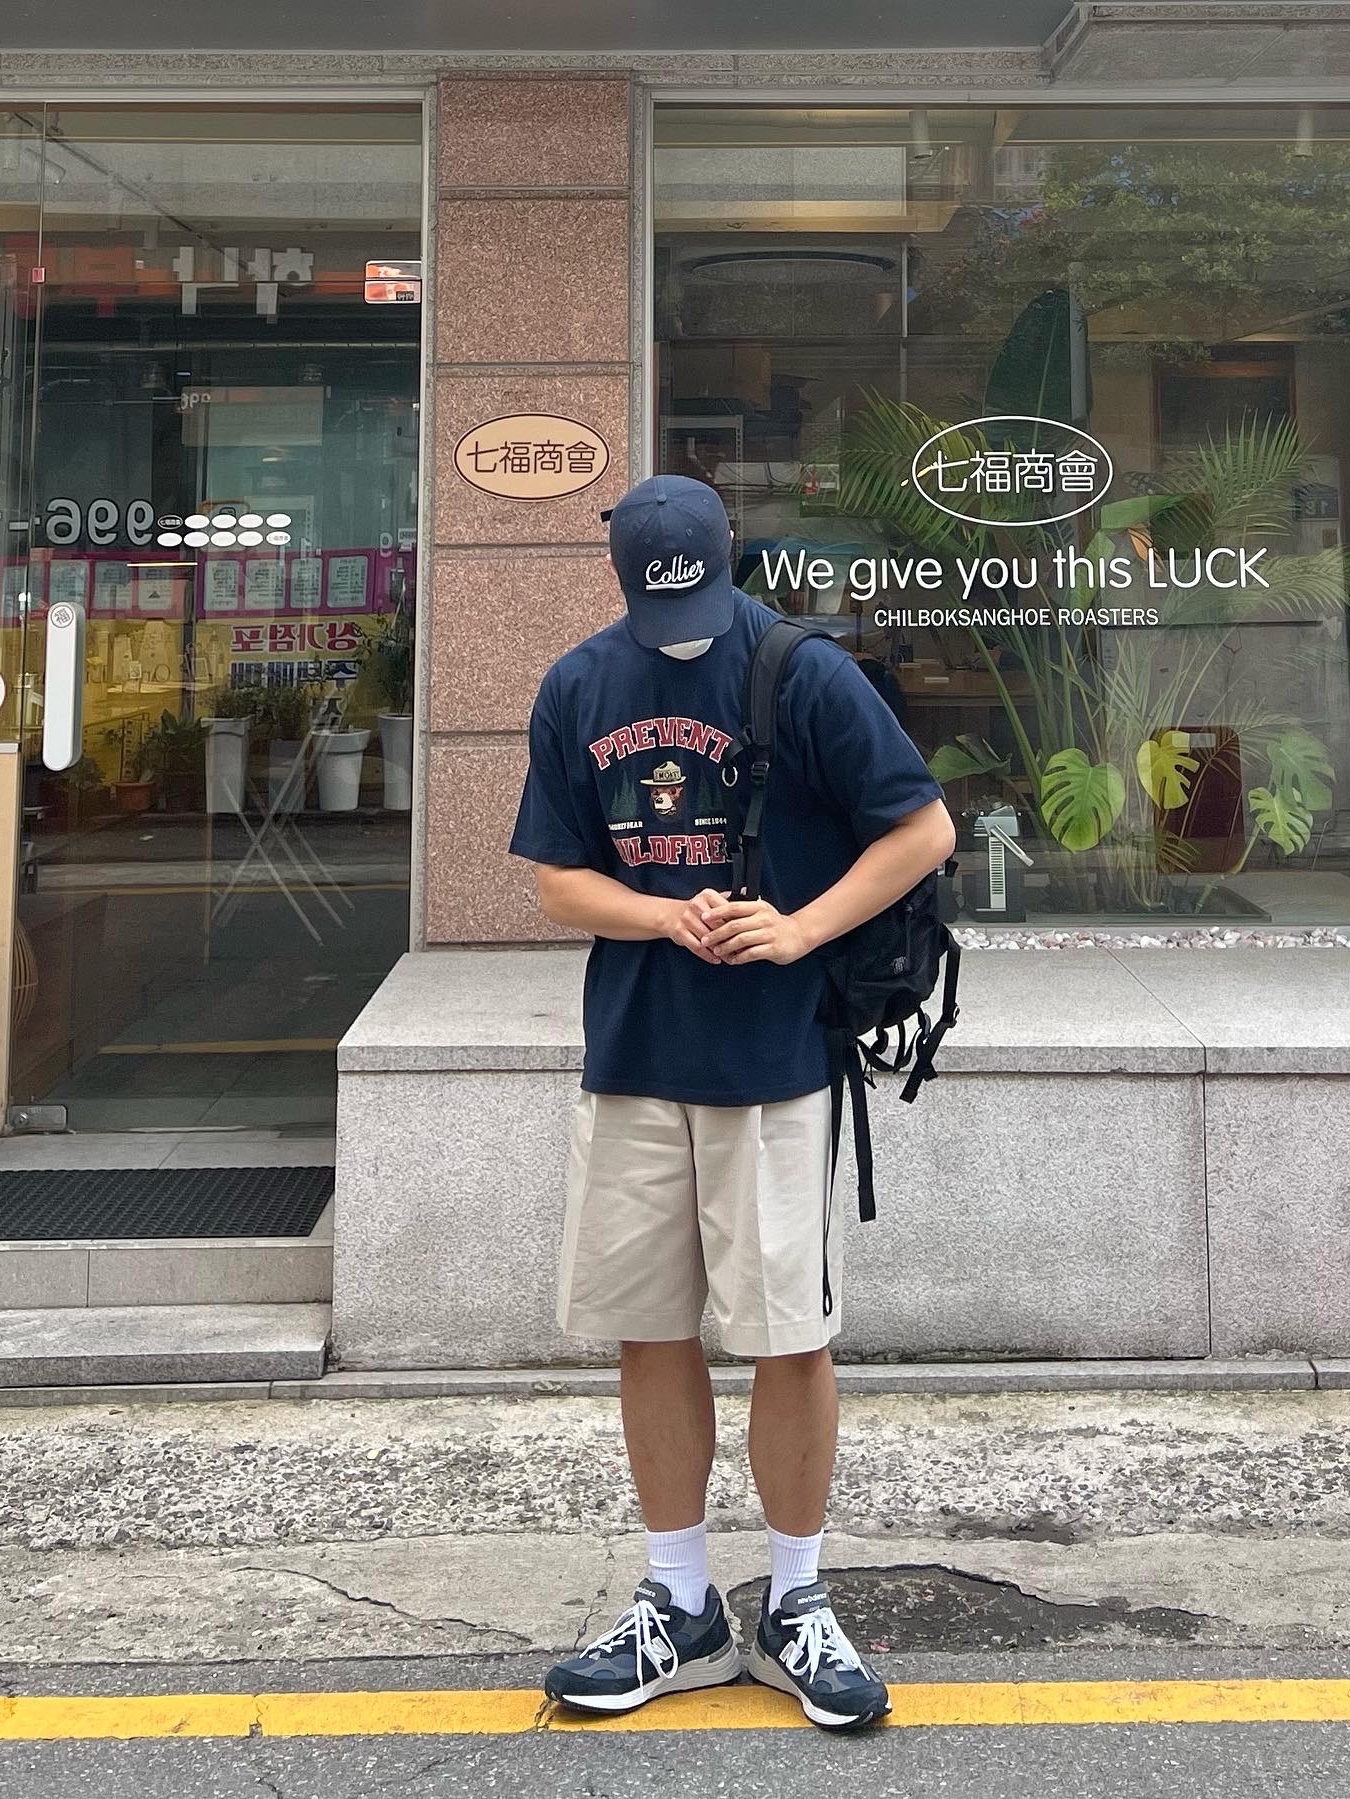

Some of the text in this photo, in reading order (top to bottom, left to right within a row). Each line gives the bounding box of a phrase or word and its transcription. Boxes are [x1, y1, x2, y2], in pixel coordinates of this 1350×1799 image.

[466, 439, 598, 475] 七福商會
[936, 449, 1099, 494] 七福商會
[645, 553, 705, 590] Collier
[762, 545, 1270, 600] We give you this LUCK
[874, 608, 1160, 627] CHILBOKSANGHOE ROASTERS
[589, 717, 733, 770] PREVENT
